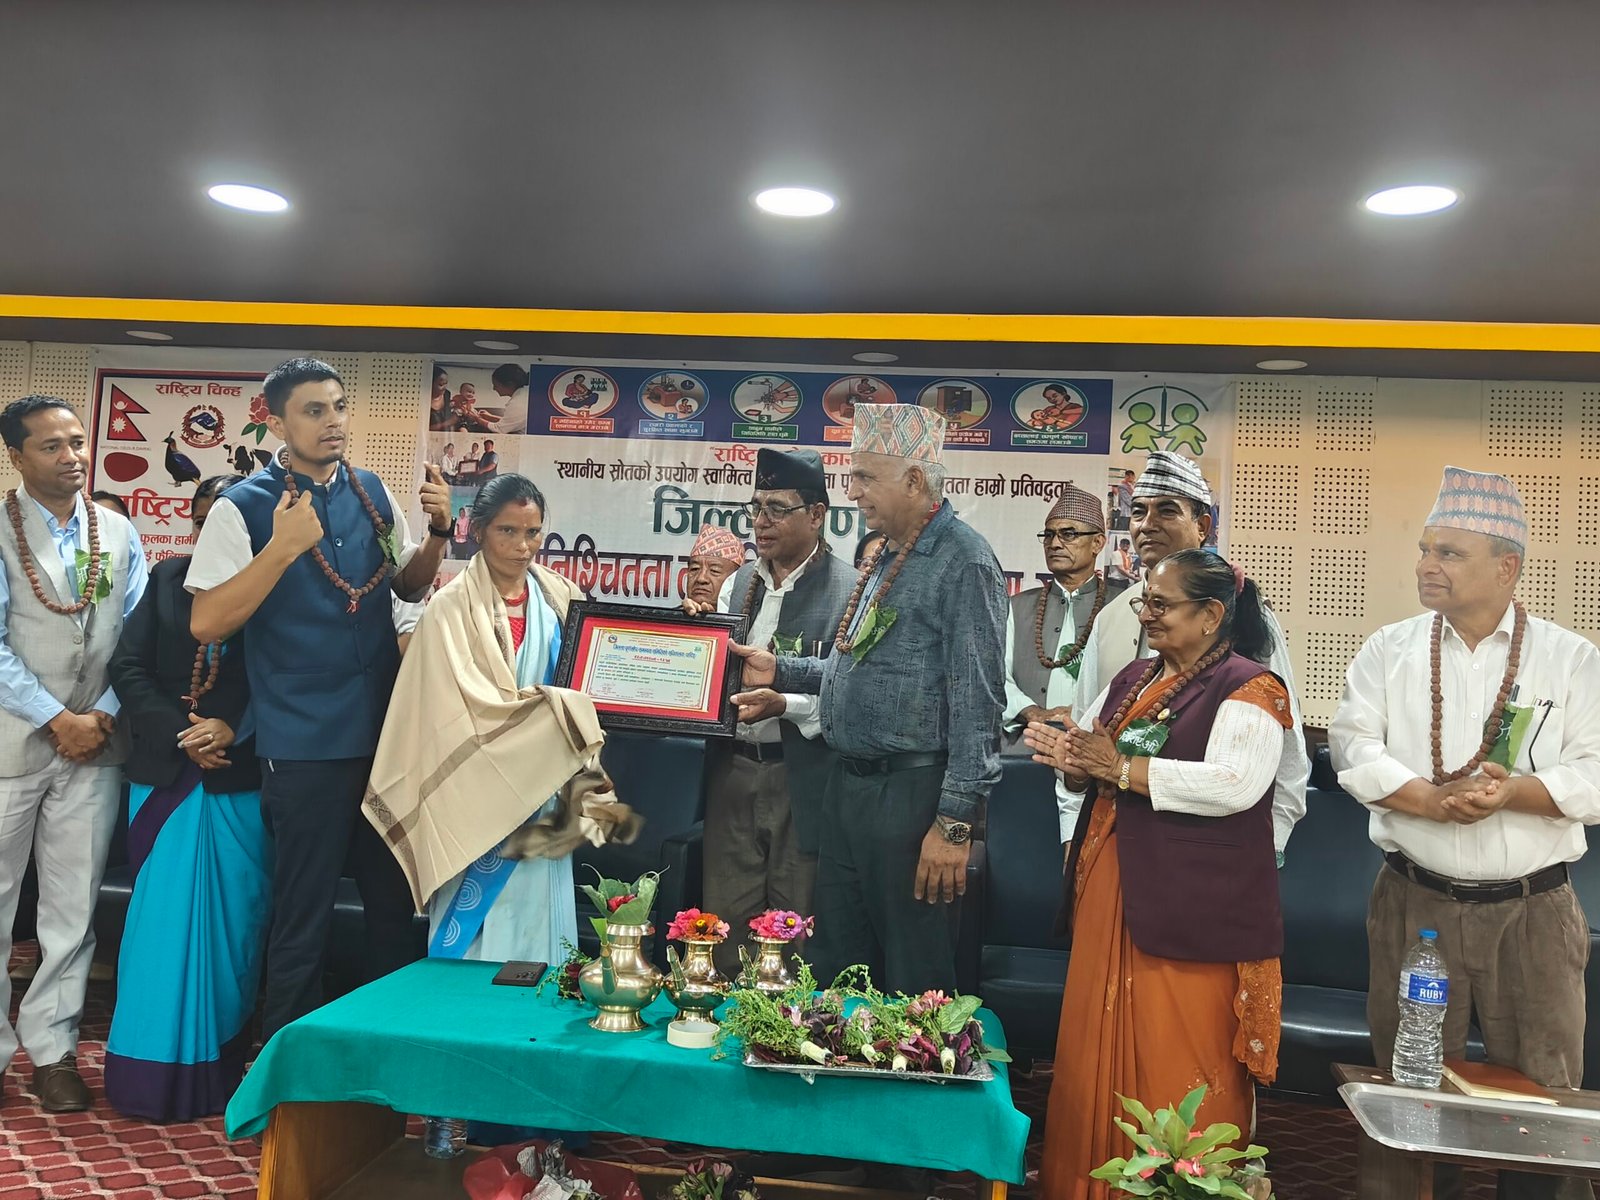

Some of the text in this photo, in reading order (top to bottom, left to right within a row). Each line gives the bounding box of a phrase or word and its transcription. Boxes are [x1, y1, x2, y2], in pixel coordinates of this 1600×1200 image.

[156, 381, 243, 398] राष्ट्रिय चिन्ह
[655, 462, 699, 484] उपयोग
[702, 463, 753, 486] स्वामित्व
[974, 474, 1007, 497] हाम्रो
[1420, 987, 1444, 1000] RUBY
